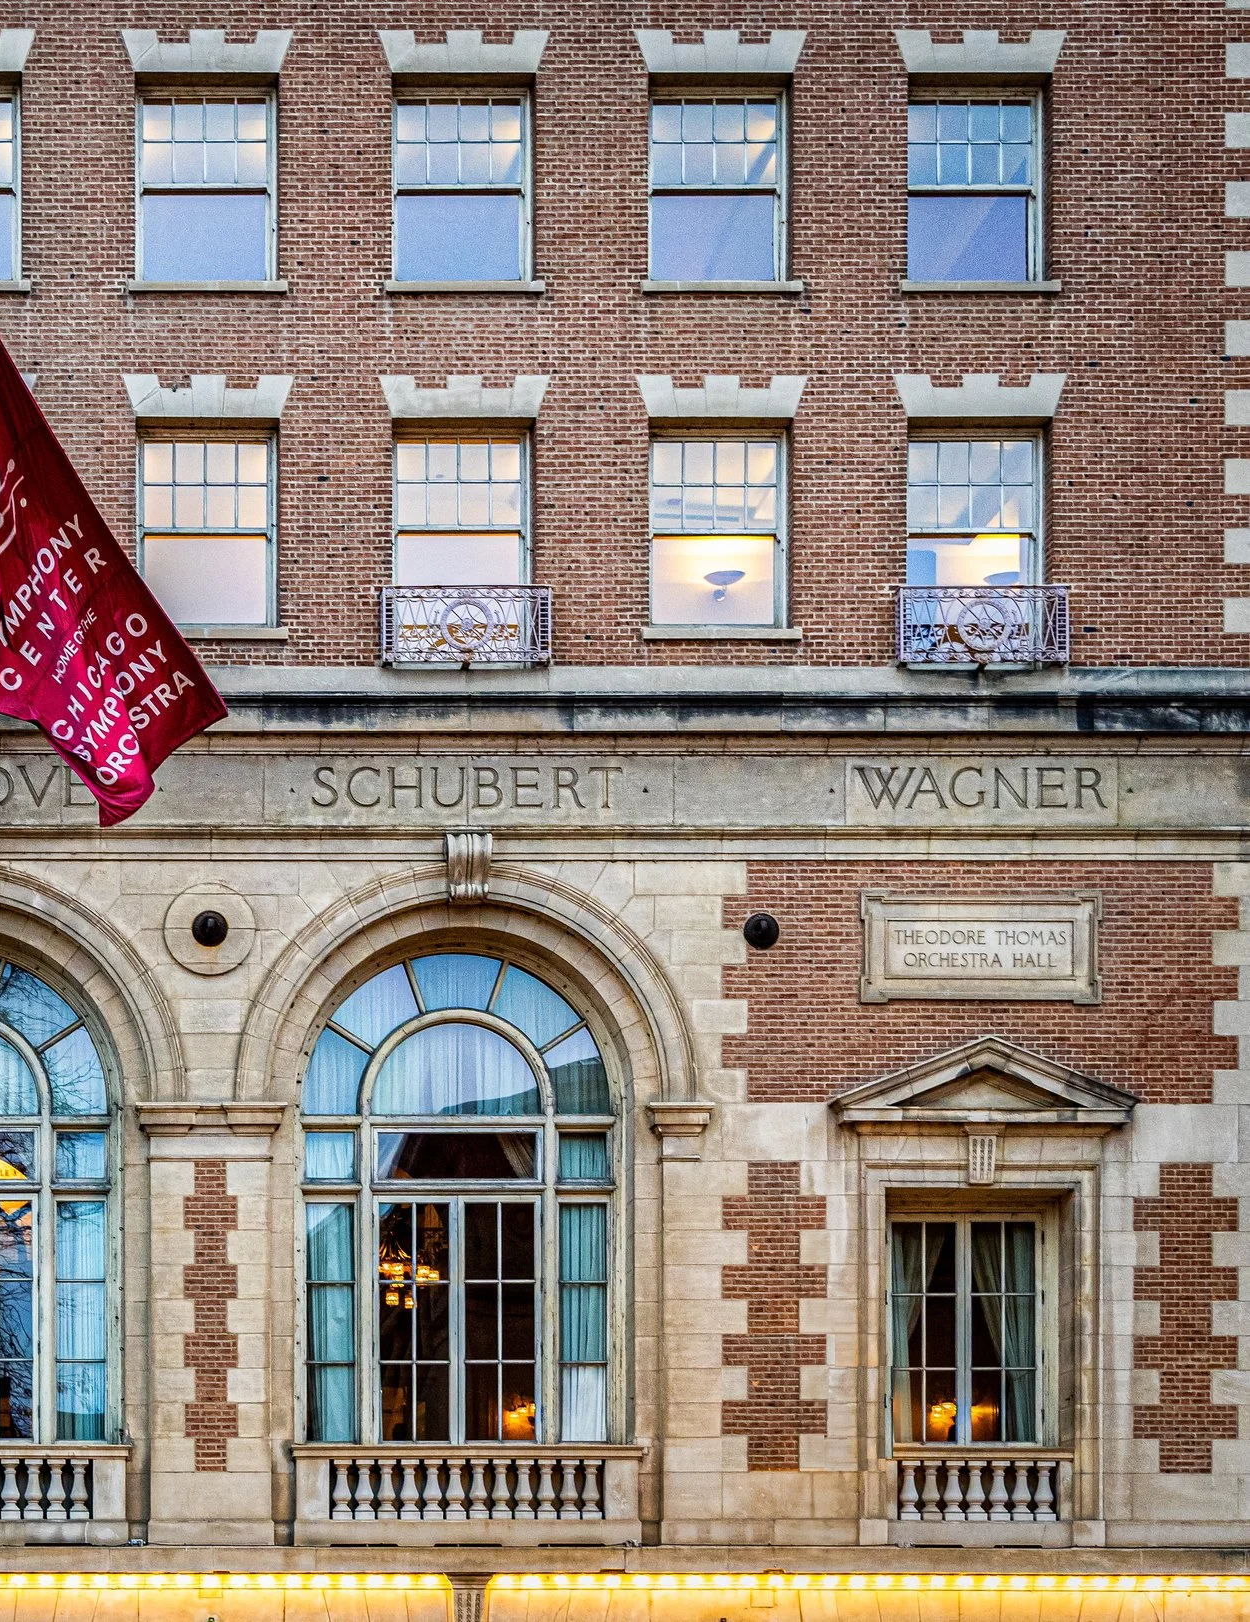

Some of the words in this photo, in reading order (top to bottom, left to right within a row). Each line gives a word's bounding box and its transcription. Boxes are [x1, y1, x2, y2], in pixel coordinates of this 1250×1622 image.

[51, 640, 80, 685] HOME
[80, 607, 98, 633] THE
[51, 612, 148, 741] CHICAGO
[95, 670, 196, 786] ORCSTRA
[311, 766, 624, 809] SCHUBERT
[853, 766, 1108, 810] WAGNER
[893, 929, 987, 946] THEODORE
[994, 929, 1067, 946] THOMAS
[903, 952, 1003, 968] ORCHESTRA
[1012, 952, 1058, 968] HALL
